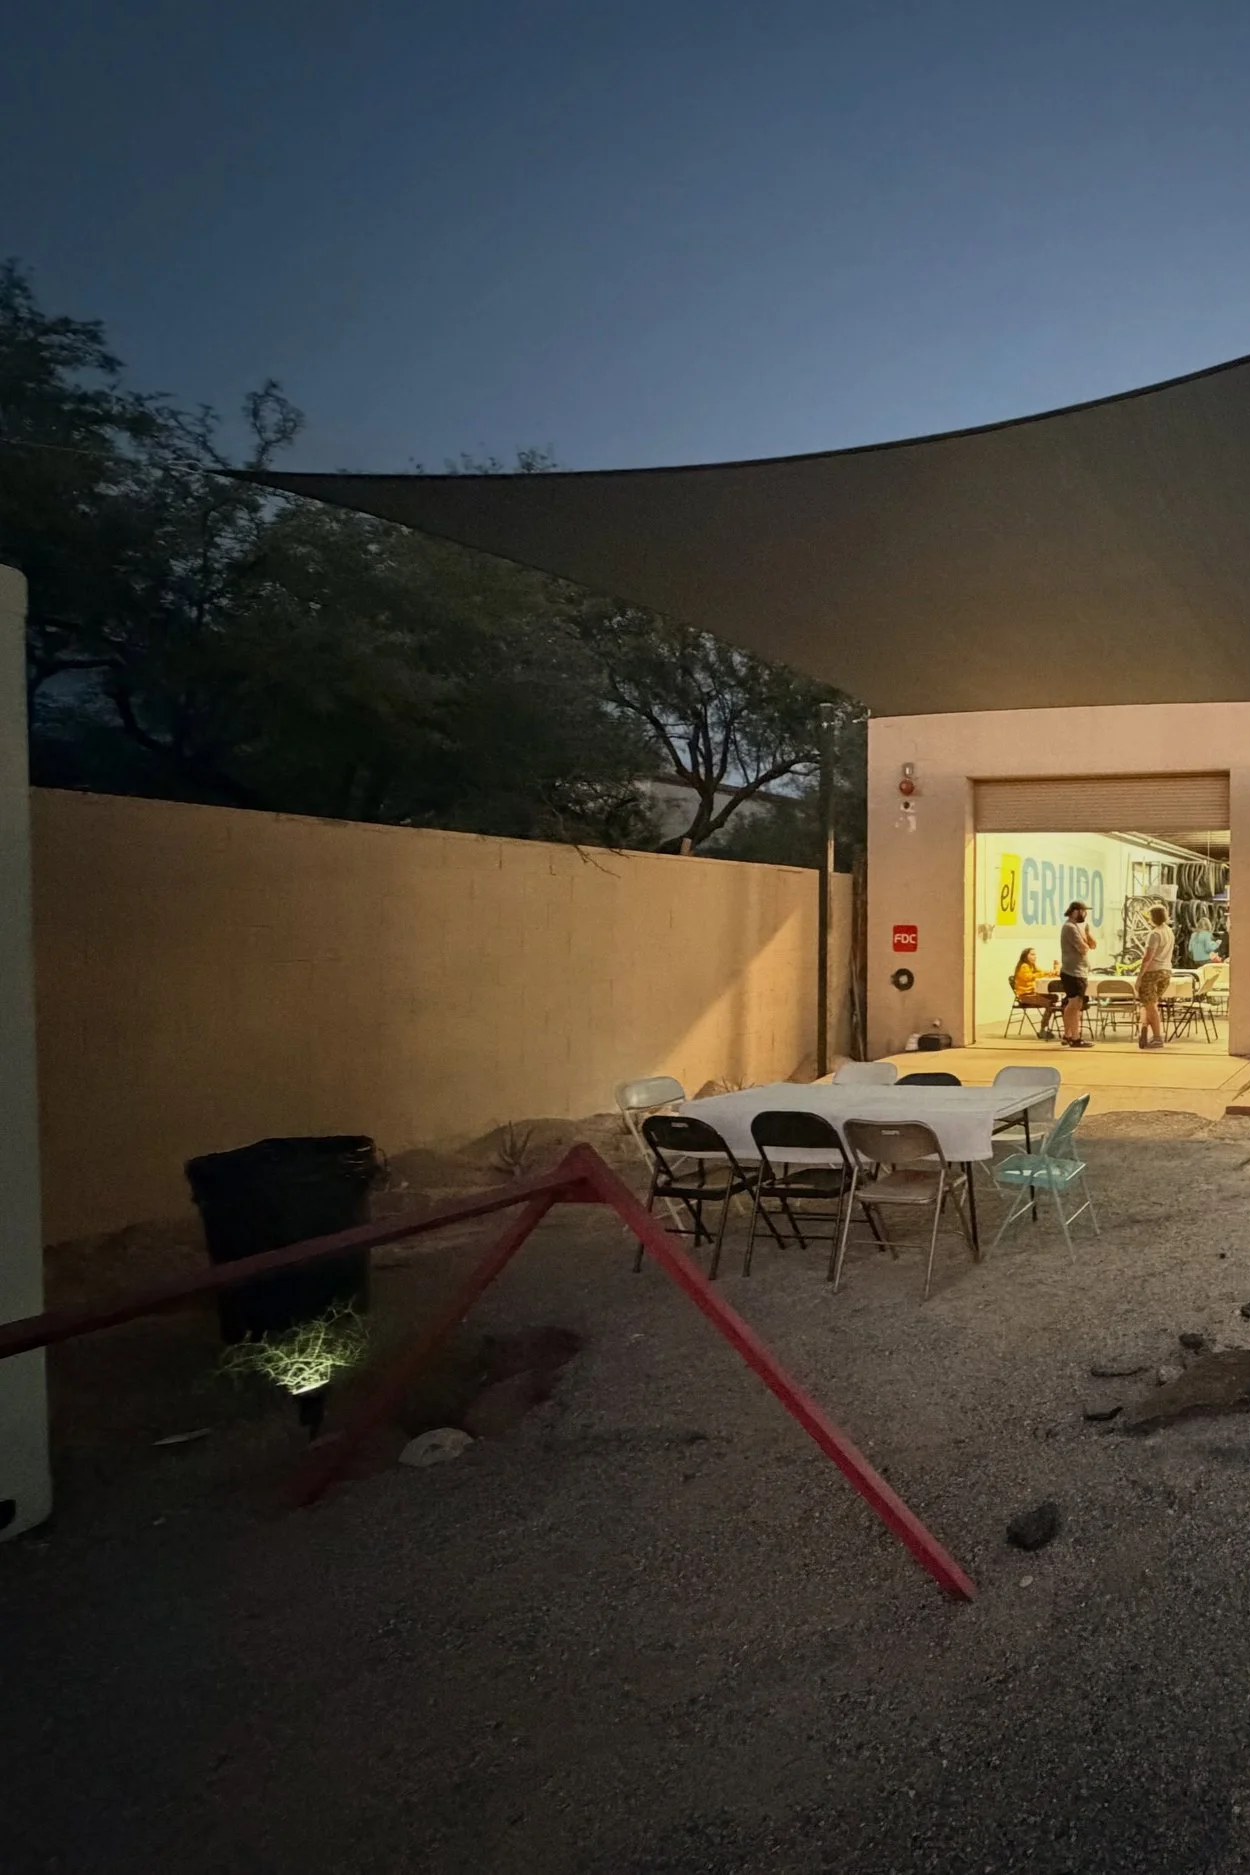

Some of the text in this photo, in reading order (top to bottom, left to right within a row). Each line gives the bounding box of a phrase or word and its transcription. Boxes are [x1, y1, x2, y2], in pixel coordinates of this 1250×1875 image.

[1000, 857, 1104, 928] el GRUPO
[894, 933, 916, 944] FDC
